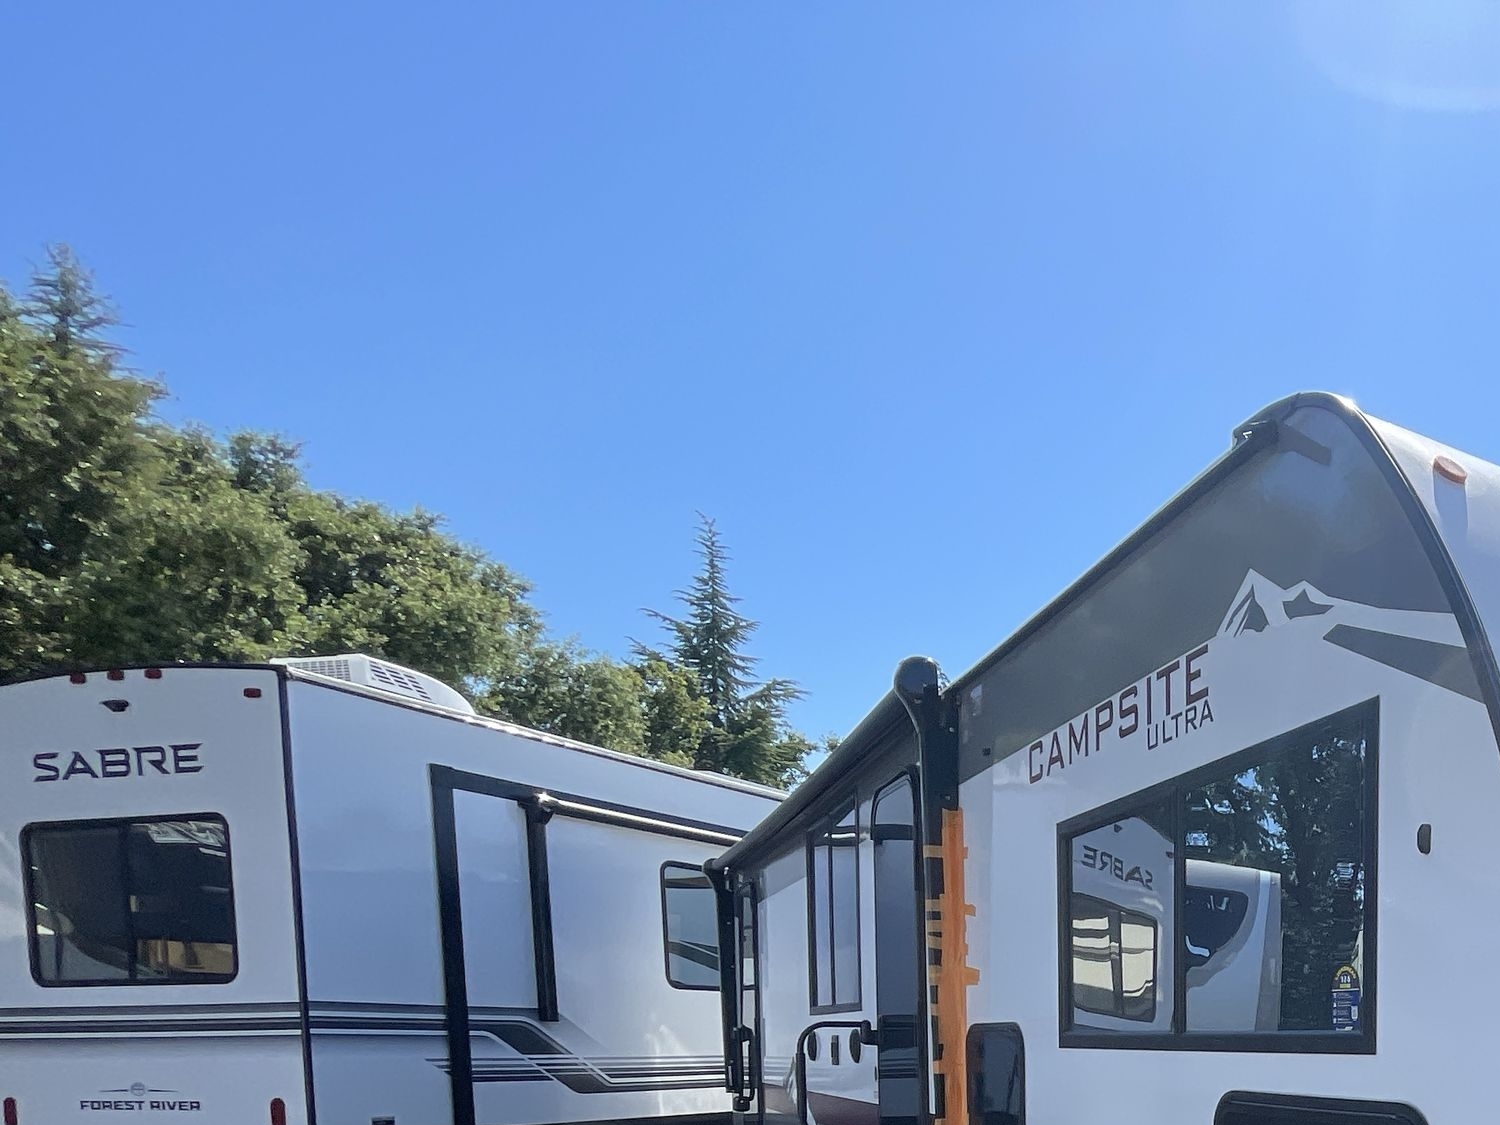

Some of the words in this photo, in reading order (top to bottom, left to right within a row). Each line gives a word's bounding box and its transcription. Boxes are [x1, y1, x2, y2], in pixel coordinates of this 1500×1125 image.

[1029, 643, 1209, 785] CAMPSITE
[1147, 698, 1214, 751] ULTRA
[33, 742, 204, 782] SABRE
[79, 1100, 145, 1111] FOREST
[149, 1100, 201, 1111] RIVER
